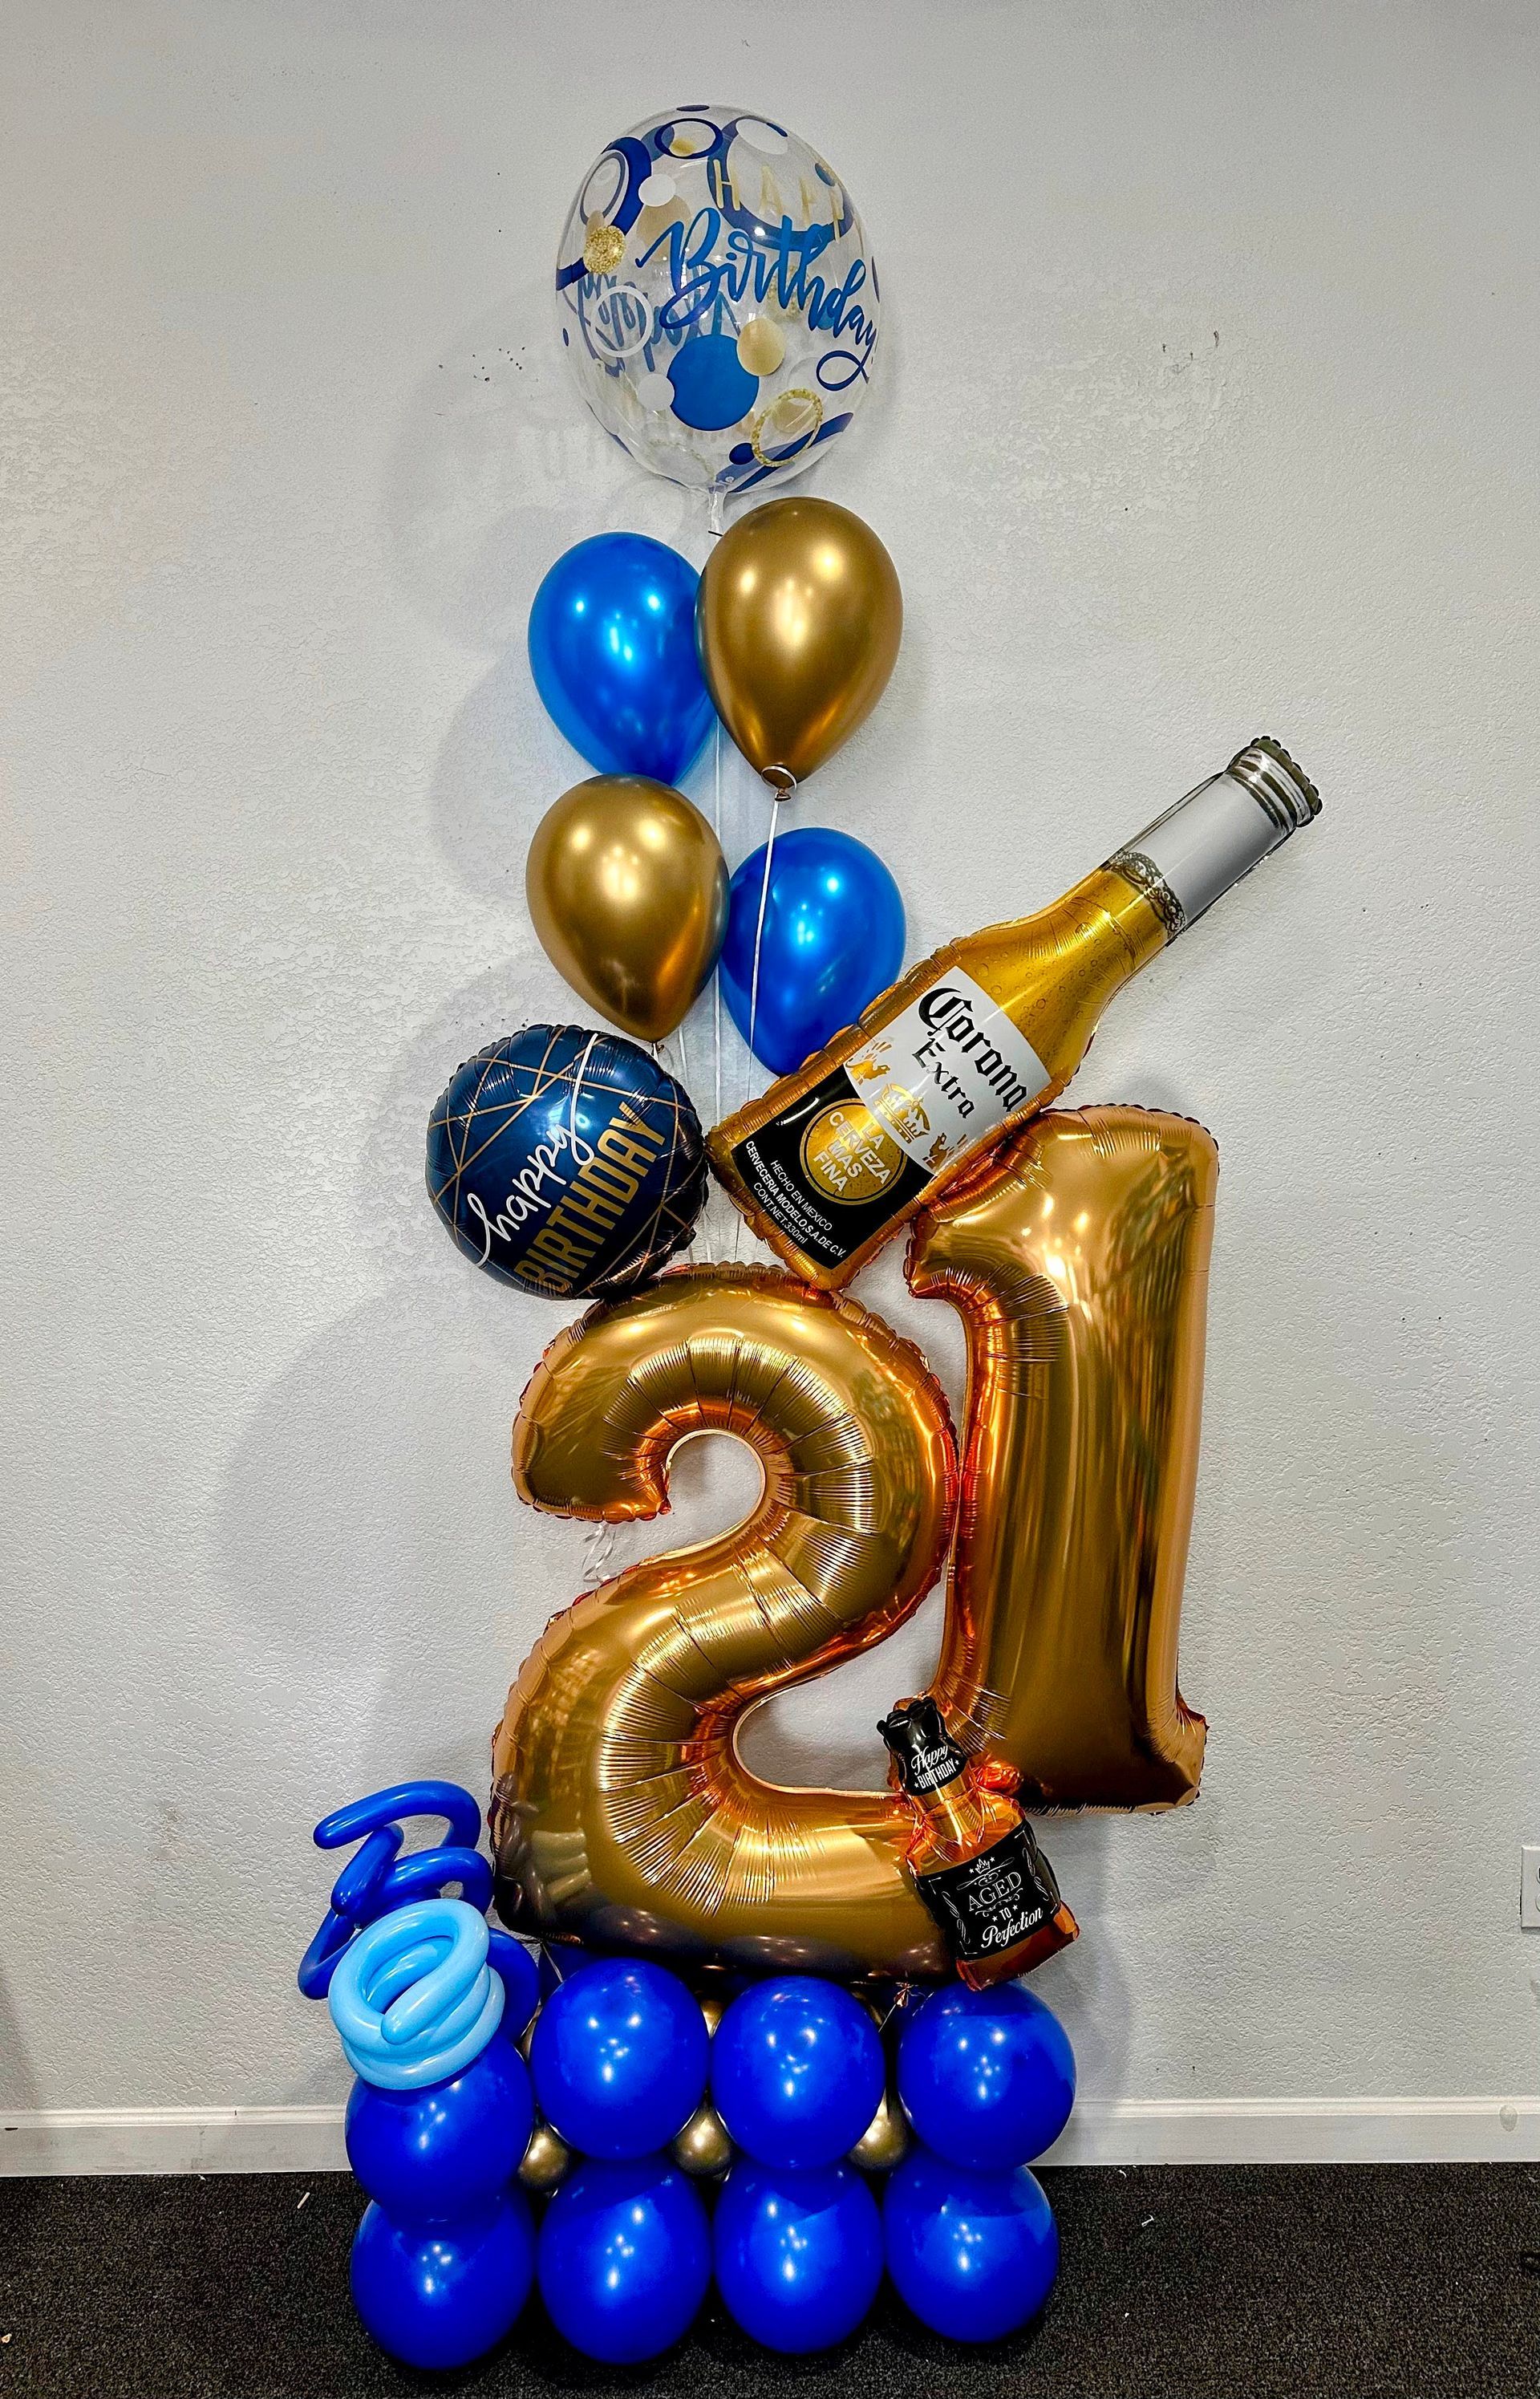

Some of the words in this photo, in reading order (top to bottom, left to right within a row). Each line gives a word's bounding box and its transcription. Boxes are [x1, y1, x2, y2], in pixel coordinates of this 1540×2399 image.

[635, 207, 877, 392] Birthday
[918, 988, 1027, 1112] Corona
[912, 1037, 975, 1118] Extra
[467, 1033, 594, 1269] happy
[828, 1139, 862, 1178] MAS
[829, 1111, 891, 1184] CERVEZA
[862, 1122, 885, 1150] LA
[746, 1141, 777, 1196] CERVECERIA
[813, 1151, 849, 1191] FINA
[513, 1102, 666, 1293] BIRTHDAY
[771, 1160, 795, 1191] HECHO
[791, 1190, 803, 1204] EN
[801, 1204, 833, 1231] MEXICO
[911, 1745, 949, 1776] Happy
[917, 1758, 957, 1789] BIRTHDAY
[969, 1871, 1022, 1911] AGED
[1000, 1908, 1011, 1921] TO
[981, 1906, 1043, 1948] Perfection
